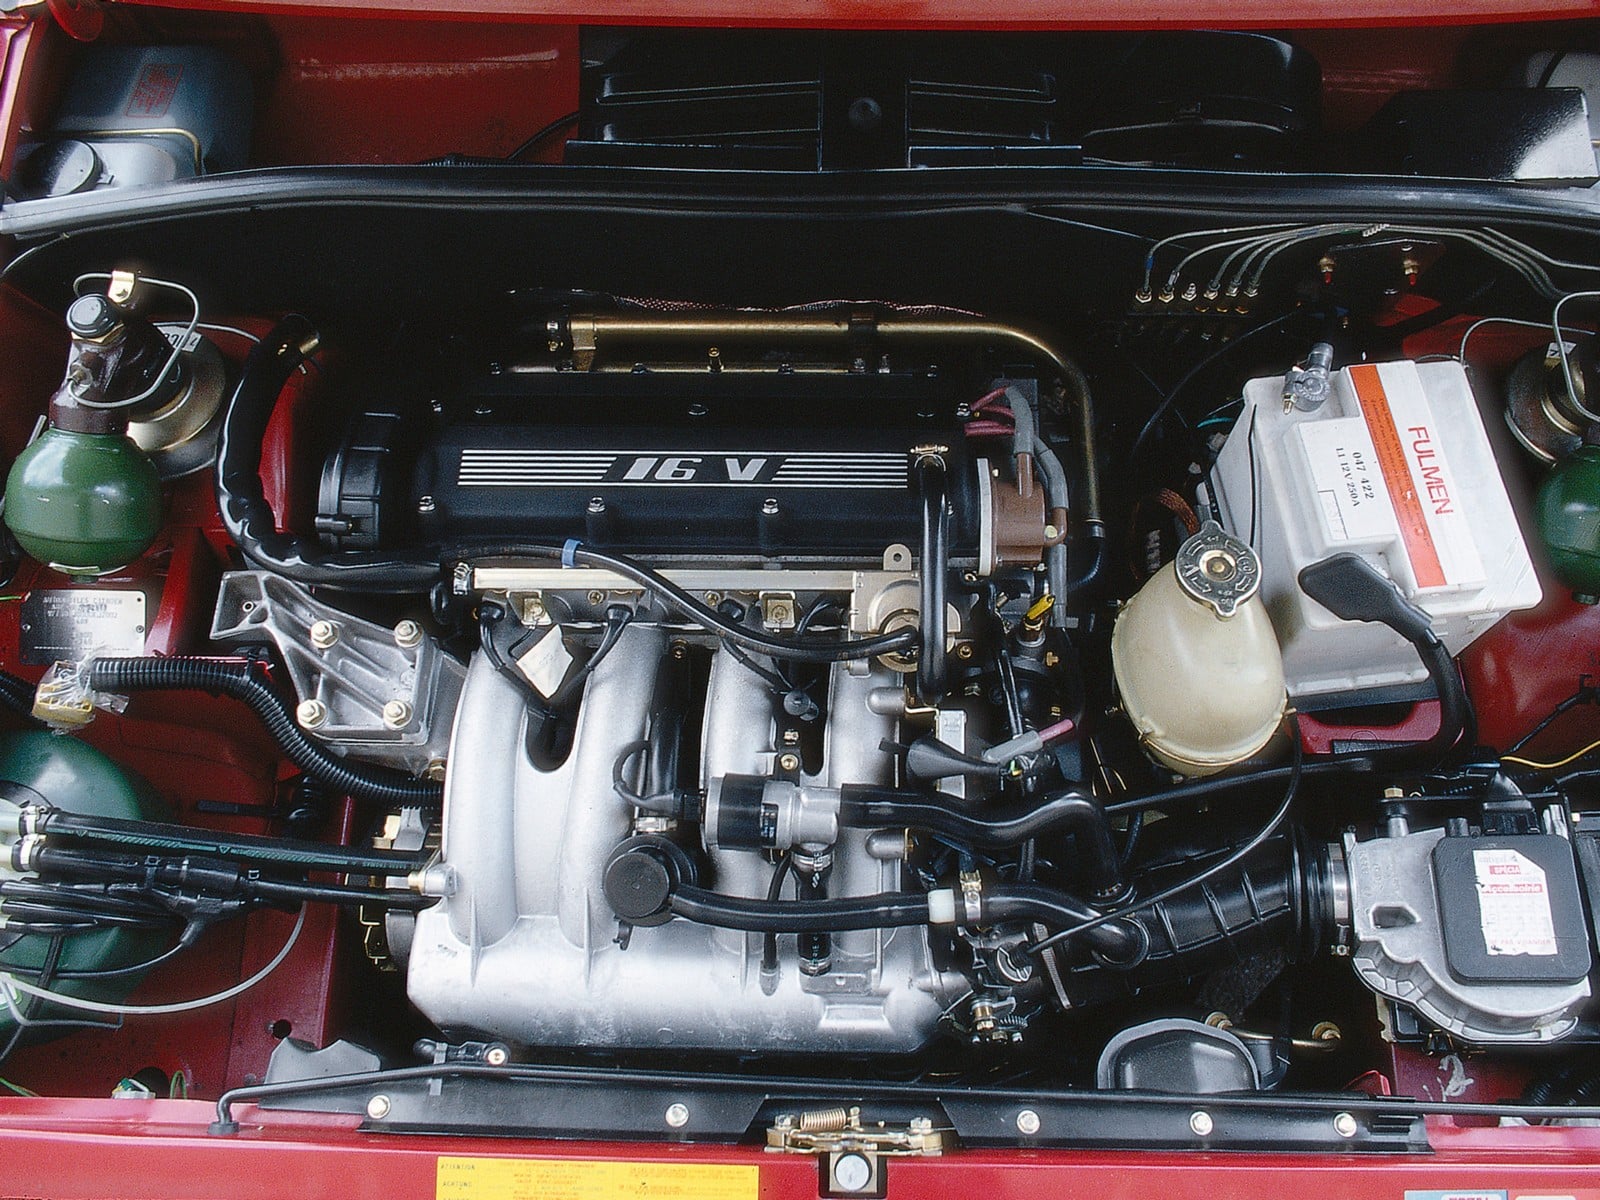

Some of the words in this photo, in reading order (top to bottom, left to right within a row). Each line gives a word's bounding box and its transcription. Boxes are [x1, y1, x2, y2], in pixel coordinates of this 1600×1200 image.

[623, 457, 702, 480] 16
[725, 458, 767, 481] V
[1340, 462, 1352, 480] 12V
[1346, 482, 1360, 506] 250A
[1352, 452, 1366, 471] 047
[1361, 478, 1374, 499] 422
[1408, 426, 1454, 515] FULMEN
